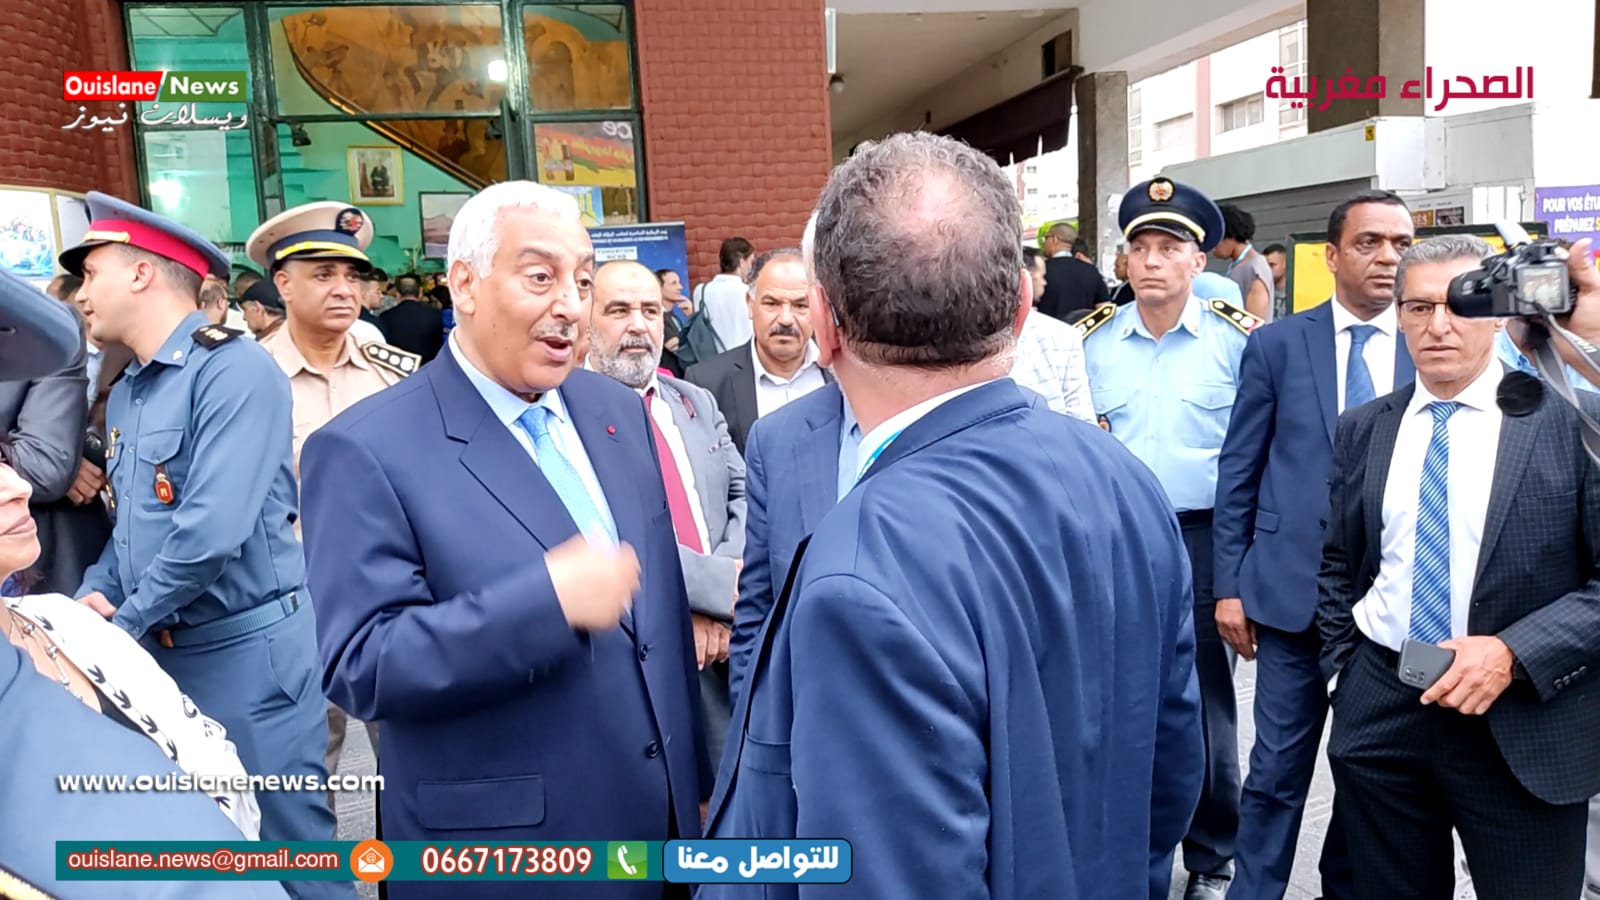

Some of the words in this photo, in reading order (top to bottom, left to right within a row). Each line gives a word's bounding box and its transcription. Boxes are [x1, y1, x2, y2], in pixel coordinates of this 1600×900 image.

[1542, 197, 1567, 213] POUR
[1567, 196, 1584, 212] VOS
[1554, 214, 1595, 233] PRÉPAREZ
